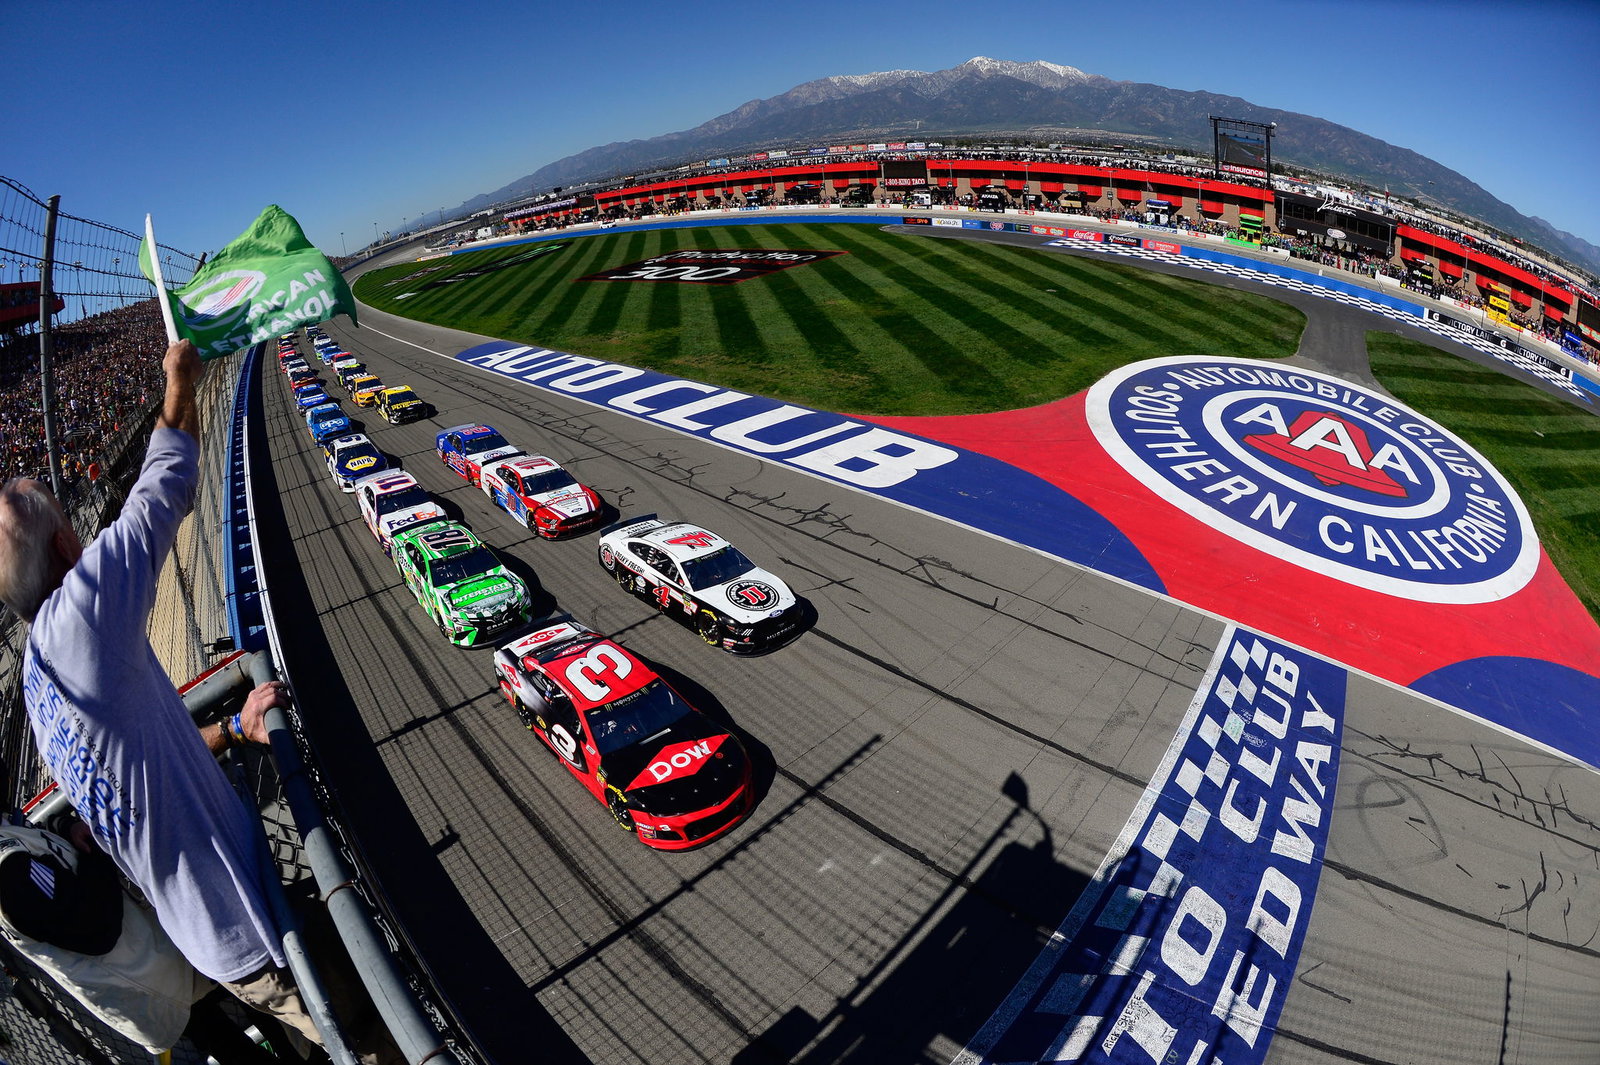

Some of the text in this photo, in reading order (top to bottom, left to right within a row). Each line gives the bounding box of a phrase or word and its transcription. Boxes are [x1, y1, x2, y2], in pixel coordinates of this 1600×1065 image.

[1230, 165, 1264, 177] Insurance
[608, 266, 741, 281] 300
[1475, 328, 1492, 340] LAN
[1539, 356, 1554, 368] LAN
[466, 347, 960, 489] AUTO CLUB
[1178, 367, 1482, 478] AUTOMOBILE CLUB
[1233, 402, 1421, 485] AAA
[350, 457, 373, 468] NAPA
[374, 474, 414, 491] 11
[1125, 385, 1507, 570] SOUTHERN CALIFORNIA
[386, 510, 438, 531] FedEx
[420, 529, 475, 552] 18
[662, 531, 716, 547] 4
[452, 582, 511, 604] INTERSTATE
[652, 586, 671, 608] 4
[486, 617, 513, 631] CAMRY
[766, 624, 796, 640] MUSTANG
[527, 630, 559, 645] DOW
[562, 645, 587, 655] DOW
[564, 644, 633, 702] 3
[37, 682, 63, 729] YOUR
[613, 691, 642, 706] MONSTER
[551, 724, 577, 761] 3
[1219, 652, 1300, 844] CLUB
[73, 711, 106, 768] MESSAGE
[104, 766, 127, 799] FROM
[648, 741, 712, 782] DOW
